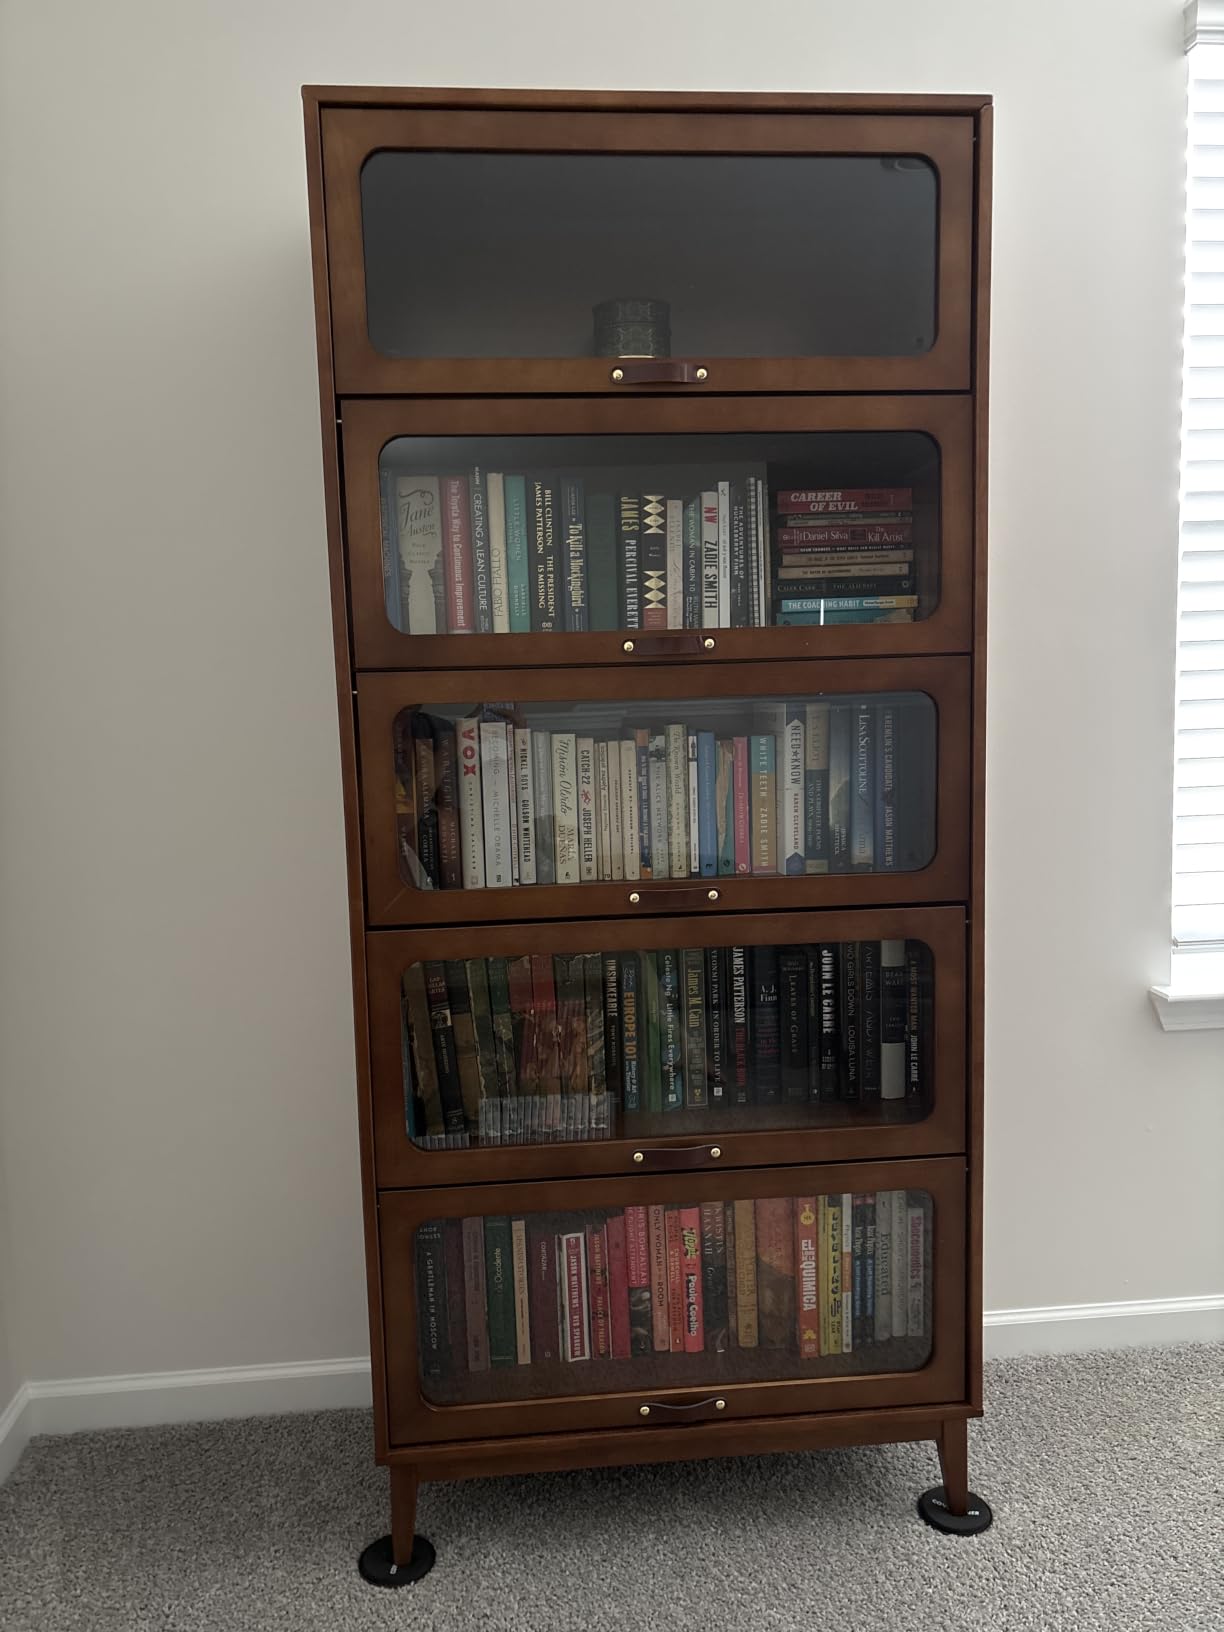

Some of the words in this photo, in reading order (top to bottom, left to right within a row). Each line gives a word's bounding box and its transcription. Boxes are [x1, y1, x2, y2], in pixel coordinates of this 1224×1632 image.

[451, 480, 460, 493] The
[535, 482, 544, 506] JAMES
[544, 489, 552, 507] BILL
[790, 492, 843, 502] CAREER
[451, 495, 460, 517] Toyota
[473, 493, 484, 538] CREATING
[620, 496, 640, 531] JAMES
[688, 504, 696, 518] THE
[704, 507, 718, 524] NW
[809, 502, 826, 512] OF
[828, 501, 859, 511] EVIL
[451, 519, 461, 532] Way
[453, 534, 460, 542] to
[536, 508, 544, 554] PATTERSON
[545, 508, 553, 546] CLINTON
[569, 523, 583, 535] To
[802, 531, 828, 540] Daniel
[830, 530, 848, 540] Silva
[867, 531, 881, 542] Kill
[882, 531, 904, 541] Artist
[476, 539, 484, 547] A
[566, 535, 583, 551] Kill
[704, 540, 718, 570] ZADIE
[453, 543, 463, 582] Continuous
[476, 549, 486, 572] LEAN
[491, 548, 502, 585] FIALLO
[537, 565, 545, 573] IS
[546, 555, 554, 572] THE
[625, 539, 638, 584] PERCIVAL
[689, 559, 697, 581] CABIN
[567, 558, 585, 607] Mockingbird
[689, 583, 697, 592] 10
[740, 570, 745, 579] OF
[477, 574, 488, 611] CULTURE
[492, 588, 504, 617] FABIO
[547, 574, 555, 617] PRESIDENT
[704, 574, 718, 608] SMITH
[839, 600, 860, 608] HABIT
[454, 583, 466, 627] Improvement
[626, 587, 639, 628] EVERETT
[673, 731, 682, 743] The
[790, 725, 801, 749] NEED
[858, 714, 870, 736] LISA
[463, 727, 477, 777] VOX
[520, 748, 530, 770] NICKEL
[672, 745, 682, 770] Known
[759, 737, 768, 767] WHITE
[440, 738, 453, 813] WARLIGHT
[581, 749, 591, 785] CATCH-22
[790, 758, 801, 785] KNOW
[858, 737, 870, 794] SCOTTOLINE
[885, 754, 893, 792] CANDIDATE
[521, 774, 530, 791] BOYS
[674, 773, 682, 795] World
[759, 770, 768, 797] TEETH
[422, 782, 431, 819] ALEMANA
[492, 790, 501, 832] MICHELLE
[559, 780, 573, 816] Olvido
[522, 799, 531, 824] COLSON
[583, 807, 592, 835] JOSEPH
[760, 807, 769, 833] ZADIE
[885, 805, 894, 827] JASON
[494, 835, 502, 867] OBAMA
[522, 827, 532, 863] WHITEHEAD
[584, 837, 593, 863] HELLER
[760, 839, 769, 867] SMITH
[885, 829, 894, 866] MATTHEWS
[664, 955, 673, 983] Celeste
[733, 947, 745, 975] JAMES
[822, 949, 835, 980] JOHN
[847, 961, 855, 987] GIRLS
[606, 959, 618, 1017] UNSHAKEABLE
[687, 968, 702, 995] James
[910, 966, 918, 985] MOST
[664, 984, 673, 997] Ng
[688, 997, 702, 1007] M.
[712, 984, 720, 1005] PARK
[734, 976, 745, 1023] PATTERSON
[788, 975, 798, 1007] LEAVES
[822, 983, 835, 995] LE
[623, 991, 637, 1037] EUROPE
[666, 1003, 674, 1023] Little
[712, 1010, 720, 1020] IN
[790, 1010, 797, 1021] OF
[847, 989, 855, 1016] DOWN
[688, 1008, 703, 1028] Cain
[713, 1021, 721, 1049] ORDER
[790, 1024, 799, 1053] GRASS
[847, 1025, 856, 1057] LOUISA
[910, 1034, 919, 1052] JOHN
[625, 1040, 637, 1059] 101
[714, 1050, 721, 1062] TO
[911, 1053, 919, 1061] LE
[666, 1044, 676, 1090] Everywhere
[848, 1058, 856, 1081] LUNA
[593, 1234, 601, 1252] JASON
[570, 1255, 578, 1275] JASON
[594, 1253, 602, 1285] MATTHEWS
[629, 1244, 637, 1284] ATTENDANT
[638, 1231, 647, 1284] BOHJALIAN
[880, 1232, 892, 1296] Educated
[571, 1276, 579, 1308] MATTHEWS
[688, 1274, 698, 1303] Paulo
[428, 1304, 435, 1313] IN
[596, 1296, 604, 1317] PALACE
[597, 1318, 604, 1326] OF
[689, 1304, 699, 1336] Coelho
[598, 1327, 606, 1354] TREASON
